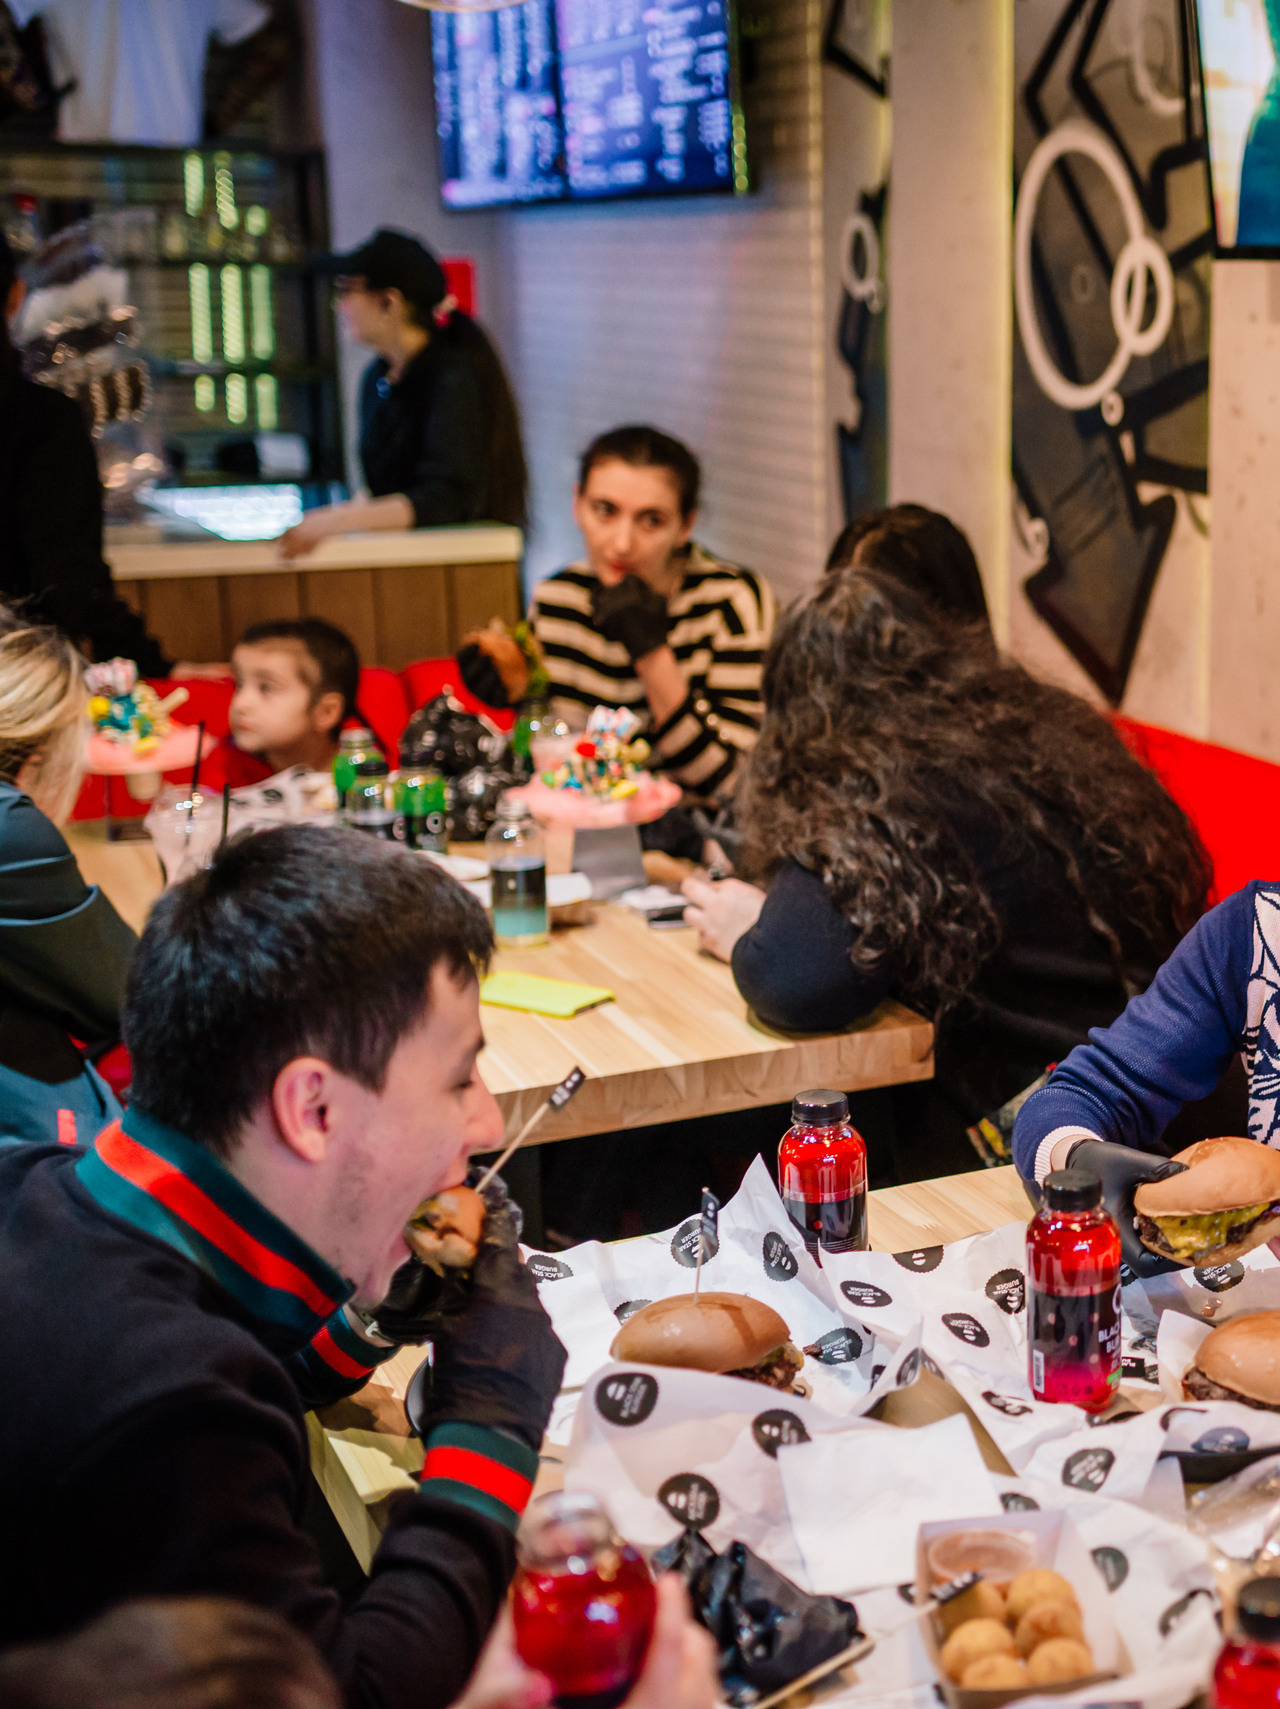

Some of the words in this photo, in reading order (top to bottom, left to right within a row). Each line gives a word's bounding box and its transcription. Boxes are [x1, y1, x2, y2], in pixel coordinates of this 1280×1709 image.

[534, 1263, 558, 1272] BURGER
[1215, 1263, 1232, 1275] BLACK
[1202, 1271, 1216, 1281] STAR
[995, 1279, 1020, 1291] BURGER
[1098, 1321, 1120, 1343] BLAC
